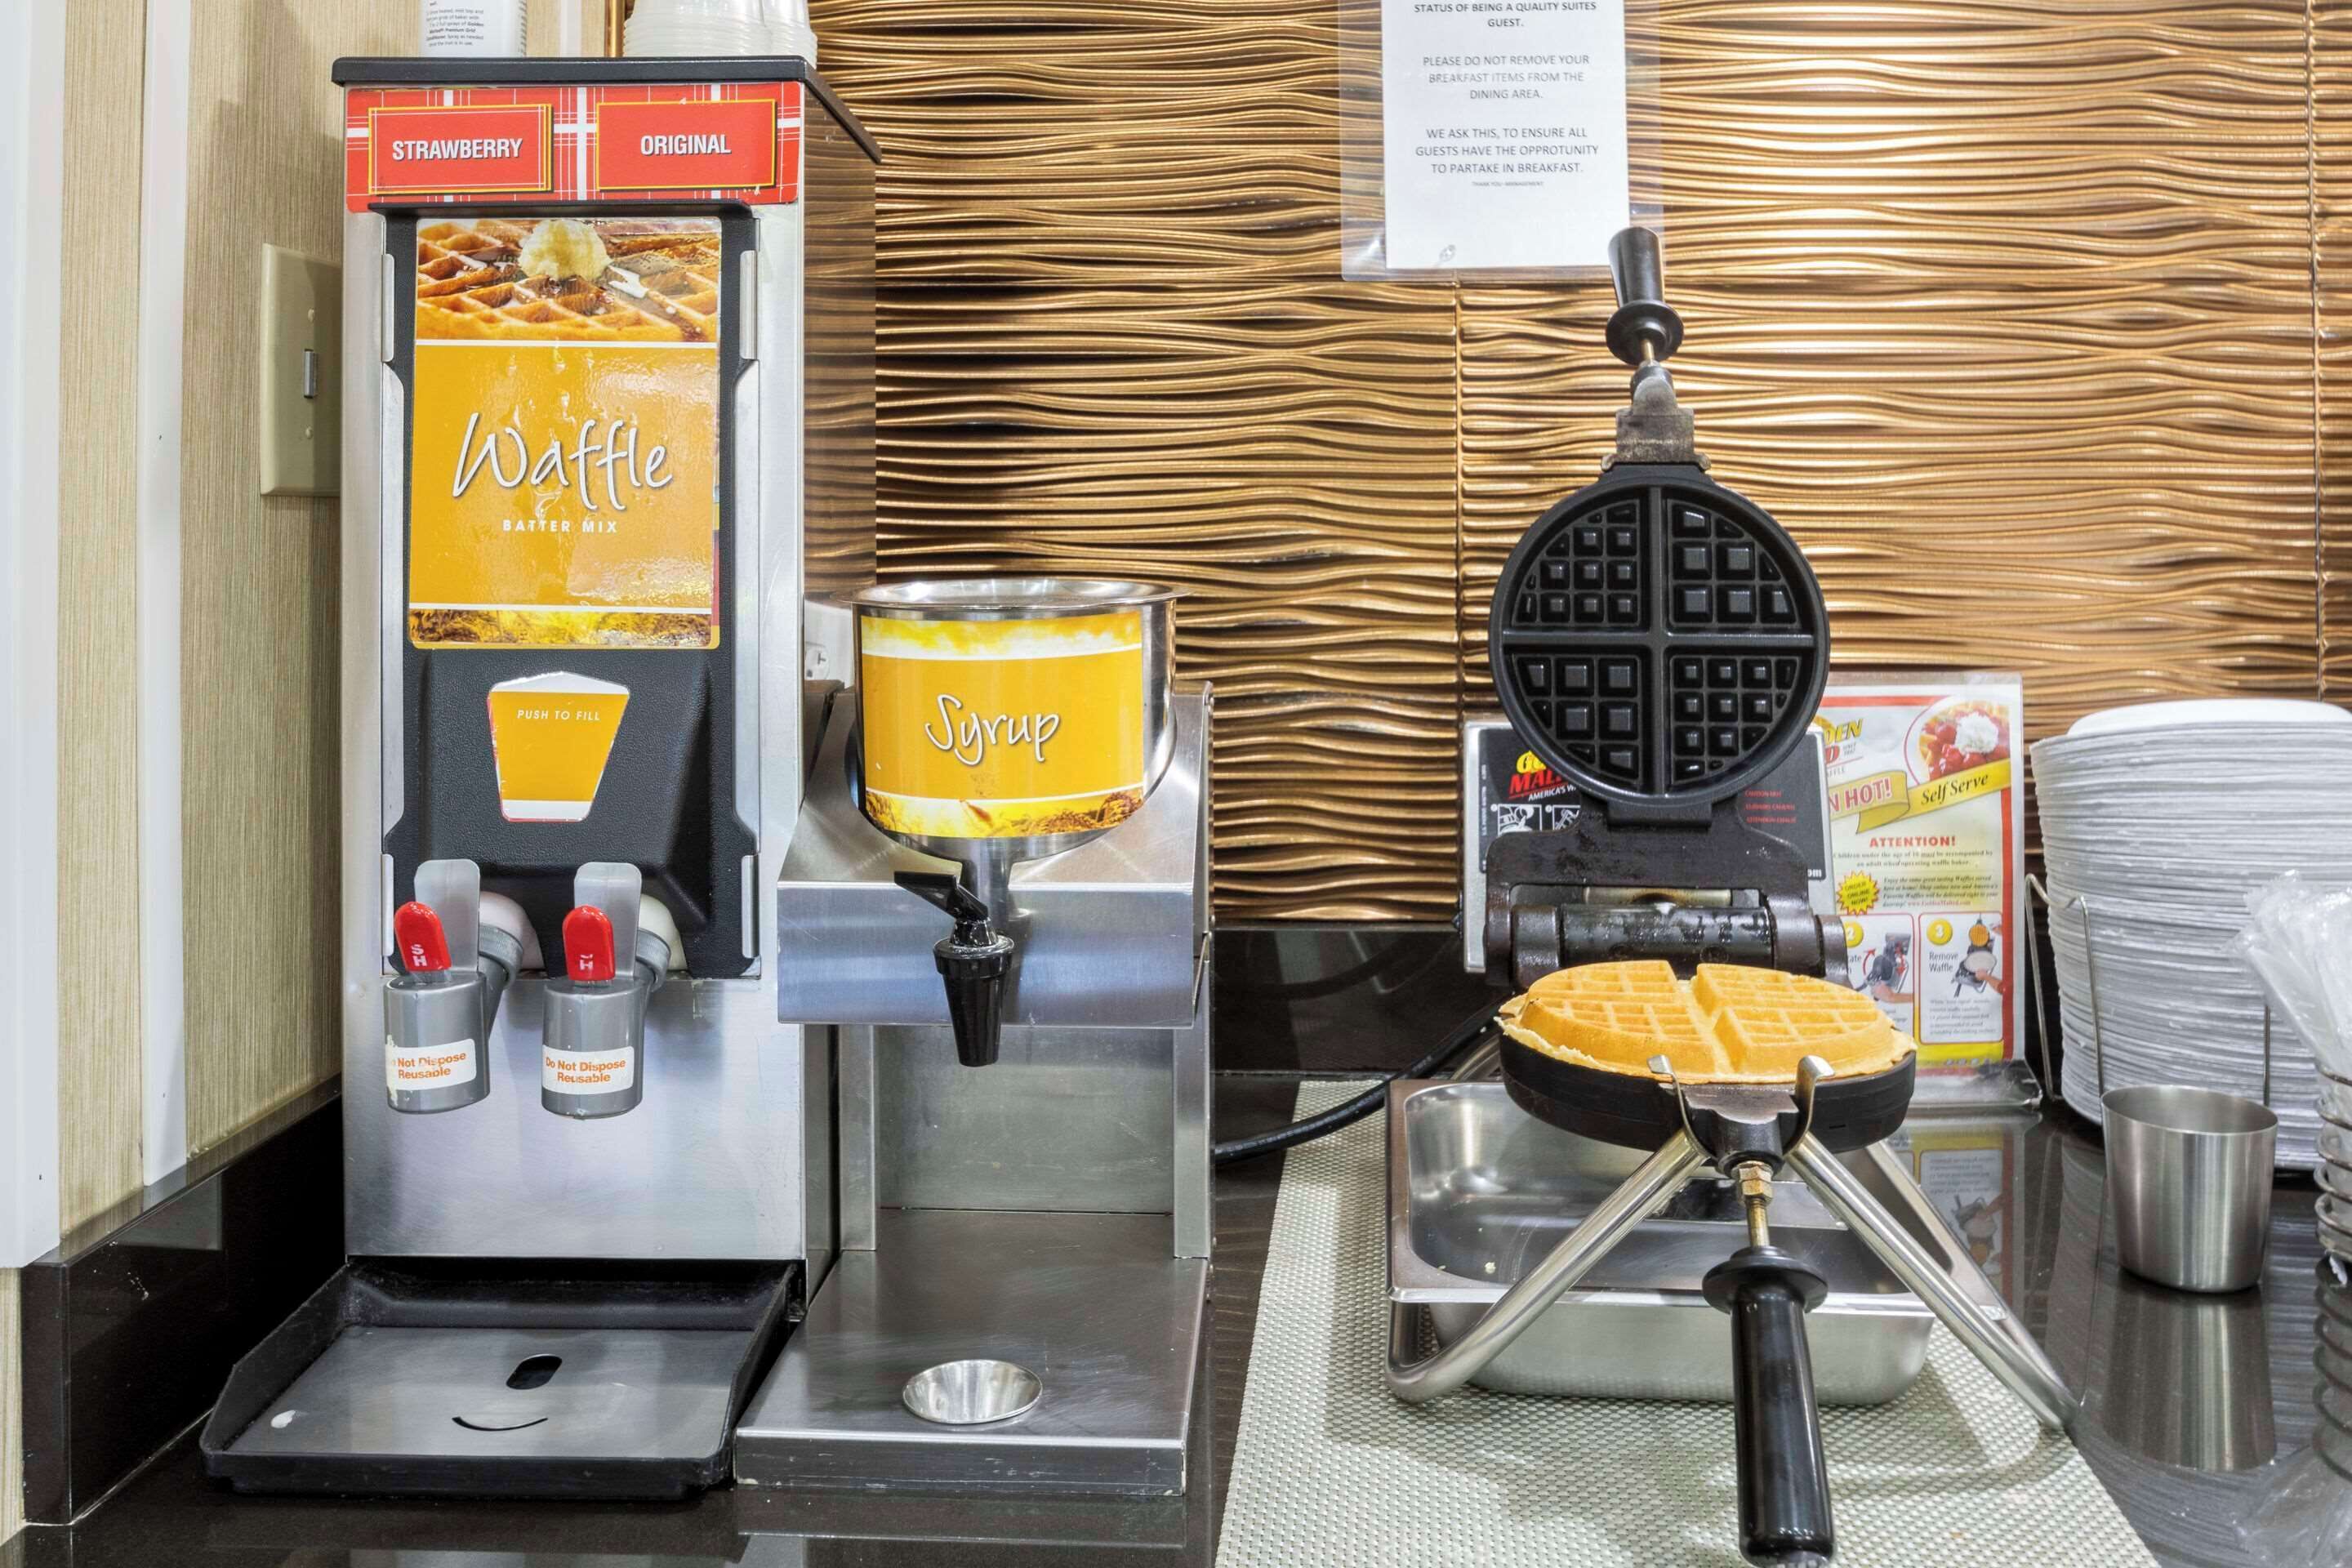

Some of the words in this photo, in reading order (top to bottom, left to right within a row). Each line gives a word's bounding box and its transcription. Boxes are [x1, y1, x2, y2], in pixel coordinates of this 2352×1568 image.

[1414, 3, 1454, 13] STATUS
[1455, 3, 1469, 12] OF
[1472, 2, 1503, 12] BEING
[1505, 2, 1513, 11] A
[1515, 2, 1559, 12] QUALITY
[1561, 1, 1597, 11] SUITES
[1487, 18, 1523, 28] GUEST.
[1423, 56, 1461, 66] PLEASE
[1463, 56, 1481, 66] DO
[1483, 55, 1507, 65] NOT
[1509, 55, 1556, 65] REMOVE
[1558, 54, 1590, 65] YOUR
[1428, 73, 1490, 84] BREAKFAST
[1491, 72, 1526, 82] ITEMS
[1527, 72, 1560, 82] FROM
[1562, 71, 1584, 82] THE
[1469, 89, 1508, 100] DINING
[1511, 89, 1544, 99] AREA.
[1426, 128, 1445, 139] WE
[1448, 128, 1469, 139] ASK
[1472, 127, 1500, 139] THIS,
[1502, 127, 1519, 138] TO
[1521, 127, 1565, 138] ENSURE
[1568, 127, 1588, 138] ALL
[391, 138, 523, 161] STRAWBERRY
[640, 134, 731, 156] ORIGINAL
[1414, 145, 1459, 157] GUESTS
[1461, 145, 1492, 156] HAVE
[1494, 145, 1517, 156] THE
[1519, 145, 1599, 156] OPPROTUNITY
[1430, 163, 1447, 174] TO
[1450, 163, 1499, 173] PARTAKE
[1503, 163, 1514, 173] IN
[1517, 163, 1584, 173] BREAKFAST.
[452, 412, 673, 511] Waffle
[502, 519, 571, 532] BATTER
[582, 521, 617, 532] MIX
[517, 710, 548, 719] PUSH
[555, 710, 570, 719] TO
[576, 711, 600, 720] FILL
[924, 693, 1060, 766] Syrup
[1844, 777, 1891, 810] HOT!
[1921, 784, 1947, 805] Self
[1949, 774, 1989, 795] Serve
[1869, 835, 1956, 848] ATTENTION!
[1929, 951, 1958, 960] Remove
[1929, 962, 1953, 973] Waffle
[398, 1057, 415, 1068] Not
[418, 1052, 467, 1067] Dispose
[546, 1056, 555, 1067] Do
[558, 1059, 577, 1071] Not
[580, 1058, 626, 1073] Dispose
[398, 1067, 452, 1079] Reusable
[557, 1072, 611, 1084] Reusable
